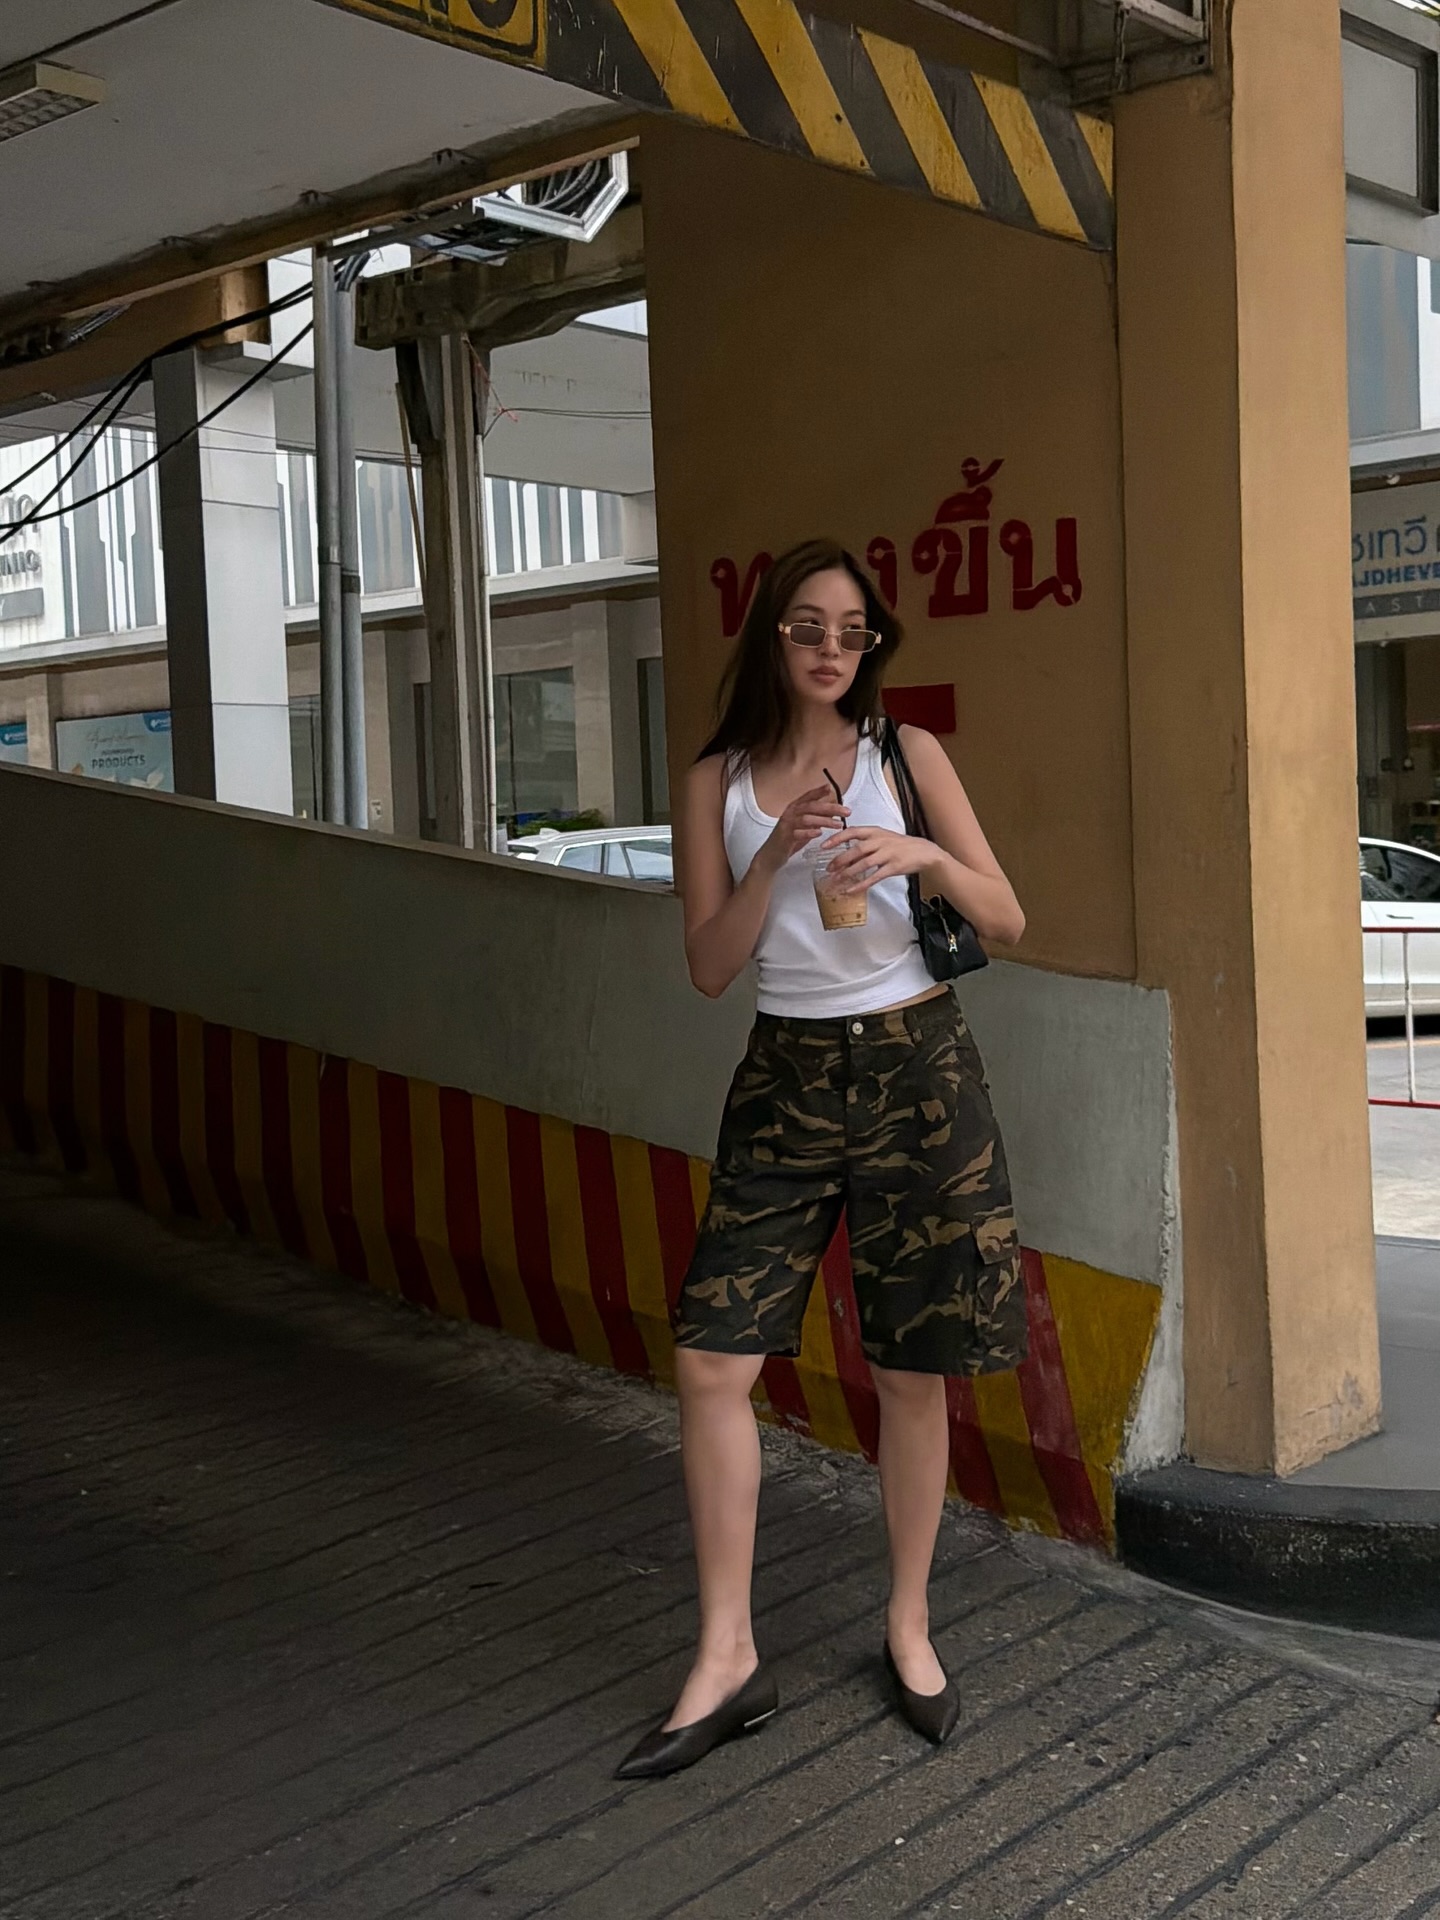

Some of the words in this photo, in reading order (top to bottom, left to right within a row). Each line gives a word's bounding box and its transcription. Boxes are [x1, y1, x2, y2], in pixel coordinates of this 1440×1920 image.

[710, 457, 1082, 637] ทงขึ้น
[1353, 562, 1440, 588] JDHEVE
[91, 754, 146, 769] PRODUCTS
